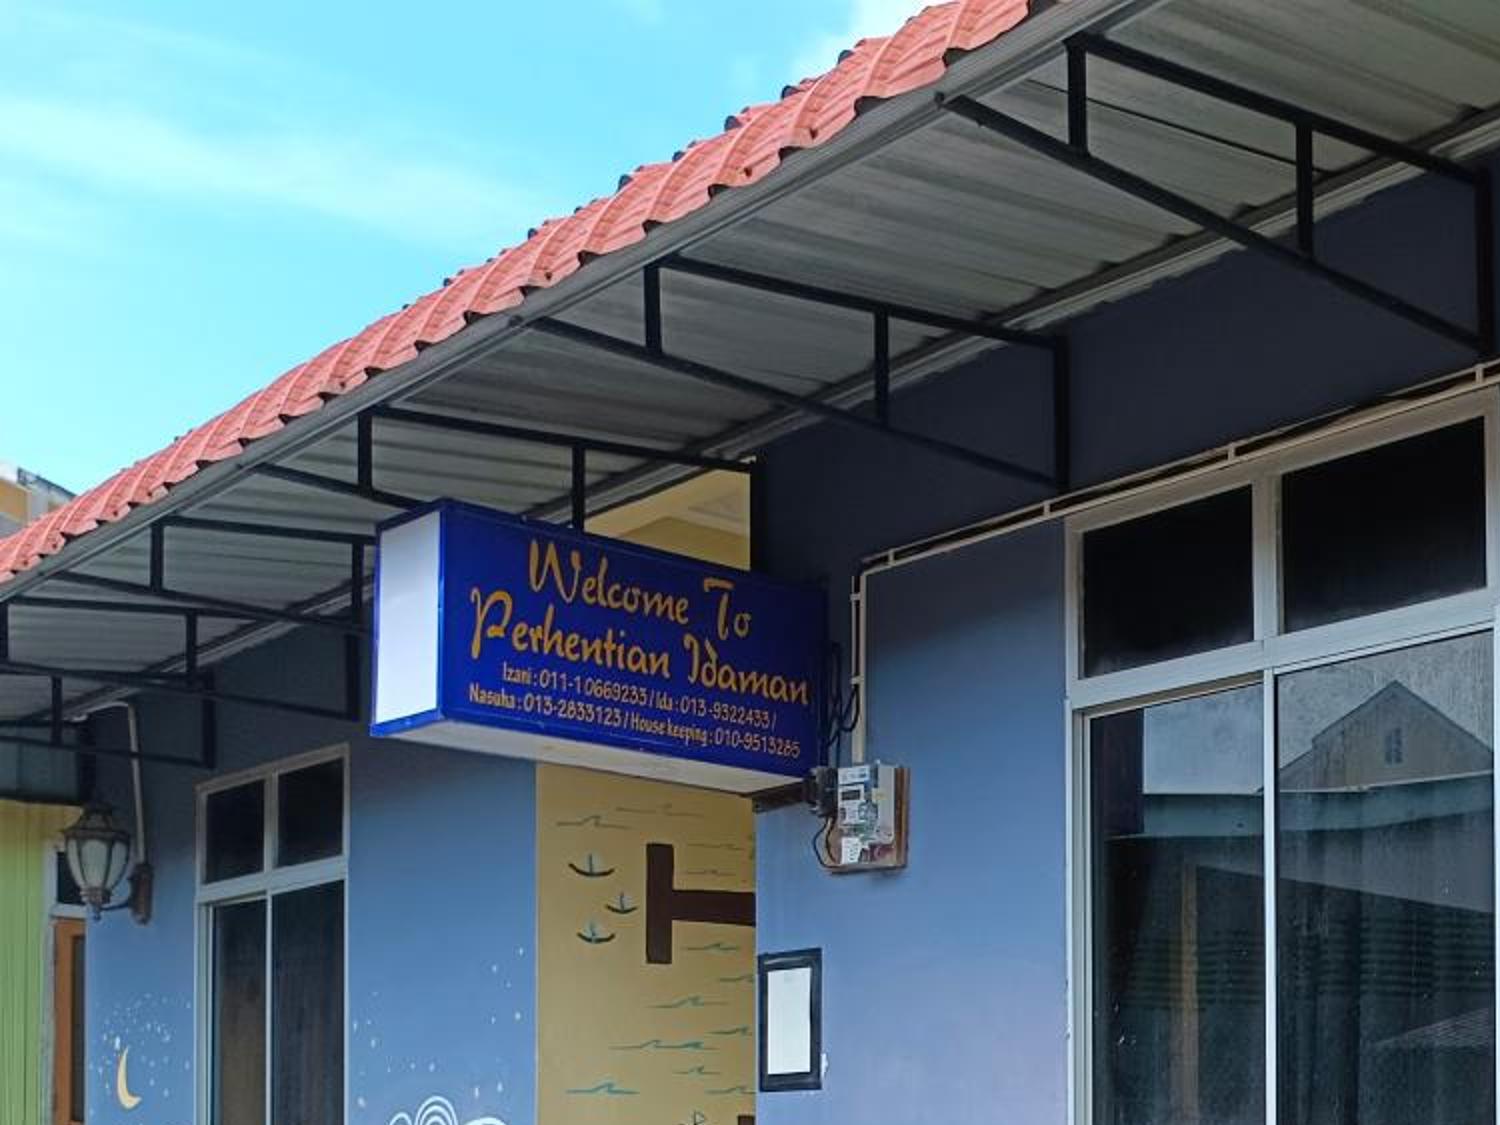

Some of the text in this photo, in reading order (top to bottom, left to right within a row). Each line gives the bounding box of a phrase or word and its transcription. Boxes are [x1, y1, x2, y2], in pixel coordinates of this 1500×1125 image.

[529, 540, 752, 640] Welcome To
[470, 587, 810, 706] Perhentian Idaman
